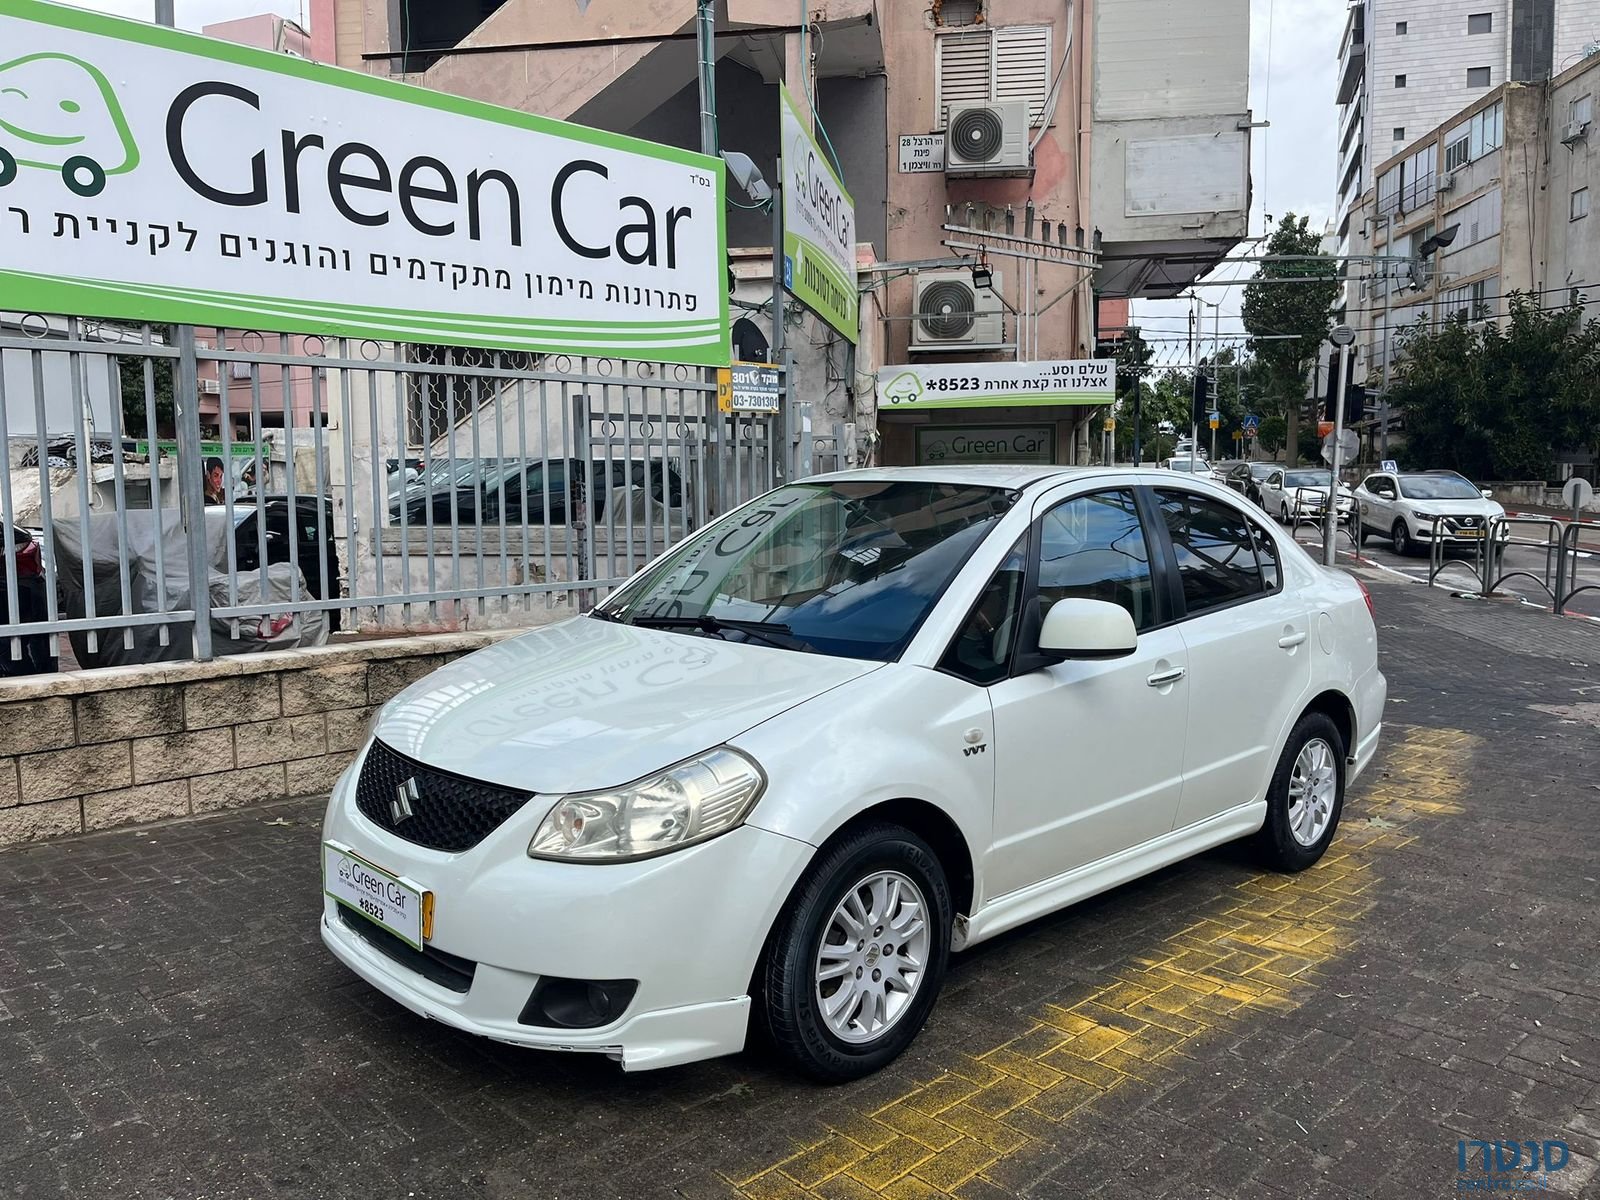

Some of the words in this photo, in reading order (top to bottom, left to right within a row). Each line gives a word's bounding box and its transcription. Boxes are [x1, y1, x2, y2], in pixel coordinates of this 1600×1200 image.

[902, 138, 911, 147] 28
[912, 136, 933, 146] הרצל
[914, 149, 930, 157] פינת
[902, 162, 907, 170] 1
[909, 161, 931, 171] וויצמן
[166, 81, 522, 247] Green
[551, 159, 692, 270] Car
[689, 174, 711, 188] בס"ד
[808, 150, 836, 234] Green
[836, 194, 850, 250] Car
[53, 211, 198, 256] לקניית
[220, 233, 351, 272] והוגנים
[370, 253, 511, 291] מתקדמים
[525, 272, 593, 300] מימון
[605, 283, 697, 312] פתרונות
[1040, 365, 1074, 376] וסע...
[1079, 363, 1108, 375] שלם
[732, 372, 750, 384] 301
[984, 379, 1019, 390] אחרת
[1053, 378, 1068, 388] זה
[1072, 376, 1108, 387] אצלנו
[1022, 379, 1049, 391] קצת
[733, 394, 778, 408] 03-7301301
[952, 435, 1008, 454] Green
[1013, 434, 1045, 453] Car
[962, 743, 987, 757] VVT
[352, 863, 385, 898] Green
[386, 882, 407, 909] Car
